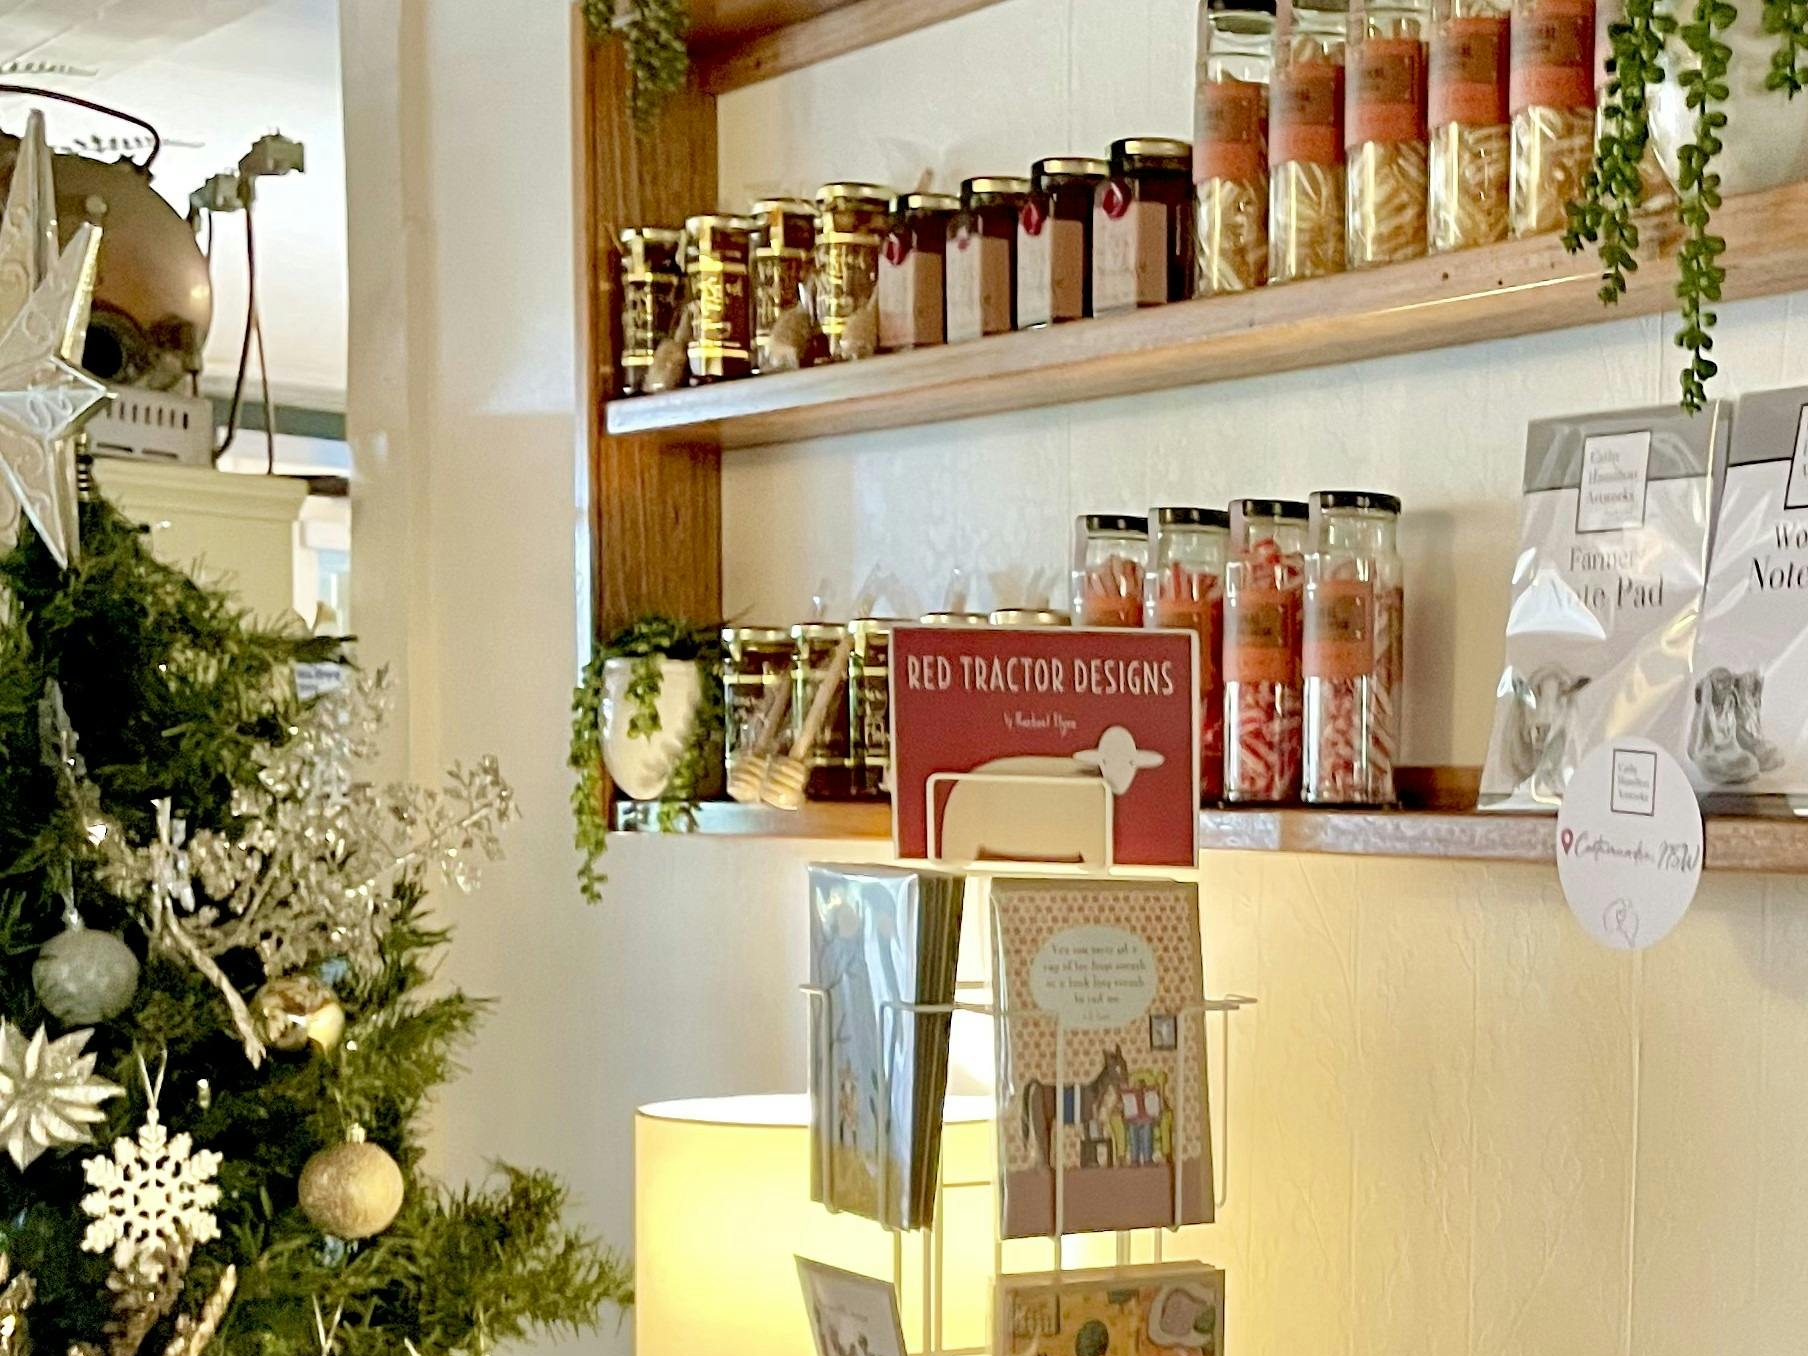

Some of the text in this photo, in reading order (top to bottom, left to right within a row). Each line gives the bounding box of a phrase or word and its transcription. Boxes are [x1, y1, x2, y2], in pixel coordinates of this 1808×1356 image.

[1616, 573, 1664, 609] Pad
[907, 655, 1175, 696] RED TRACTOR DESIGNS
